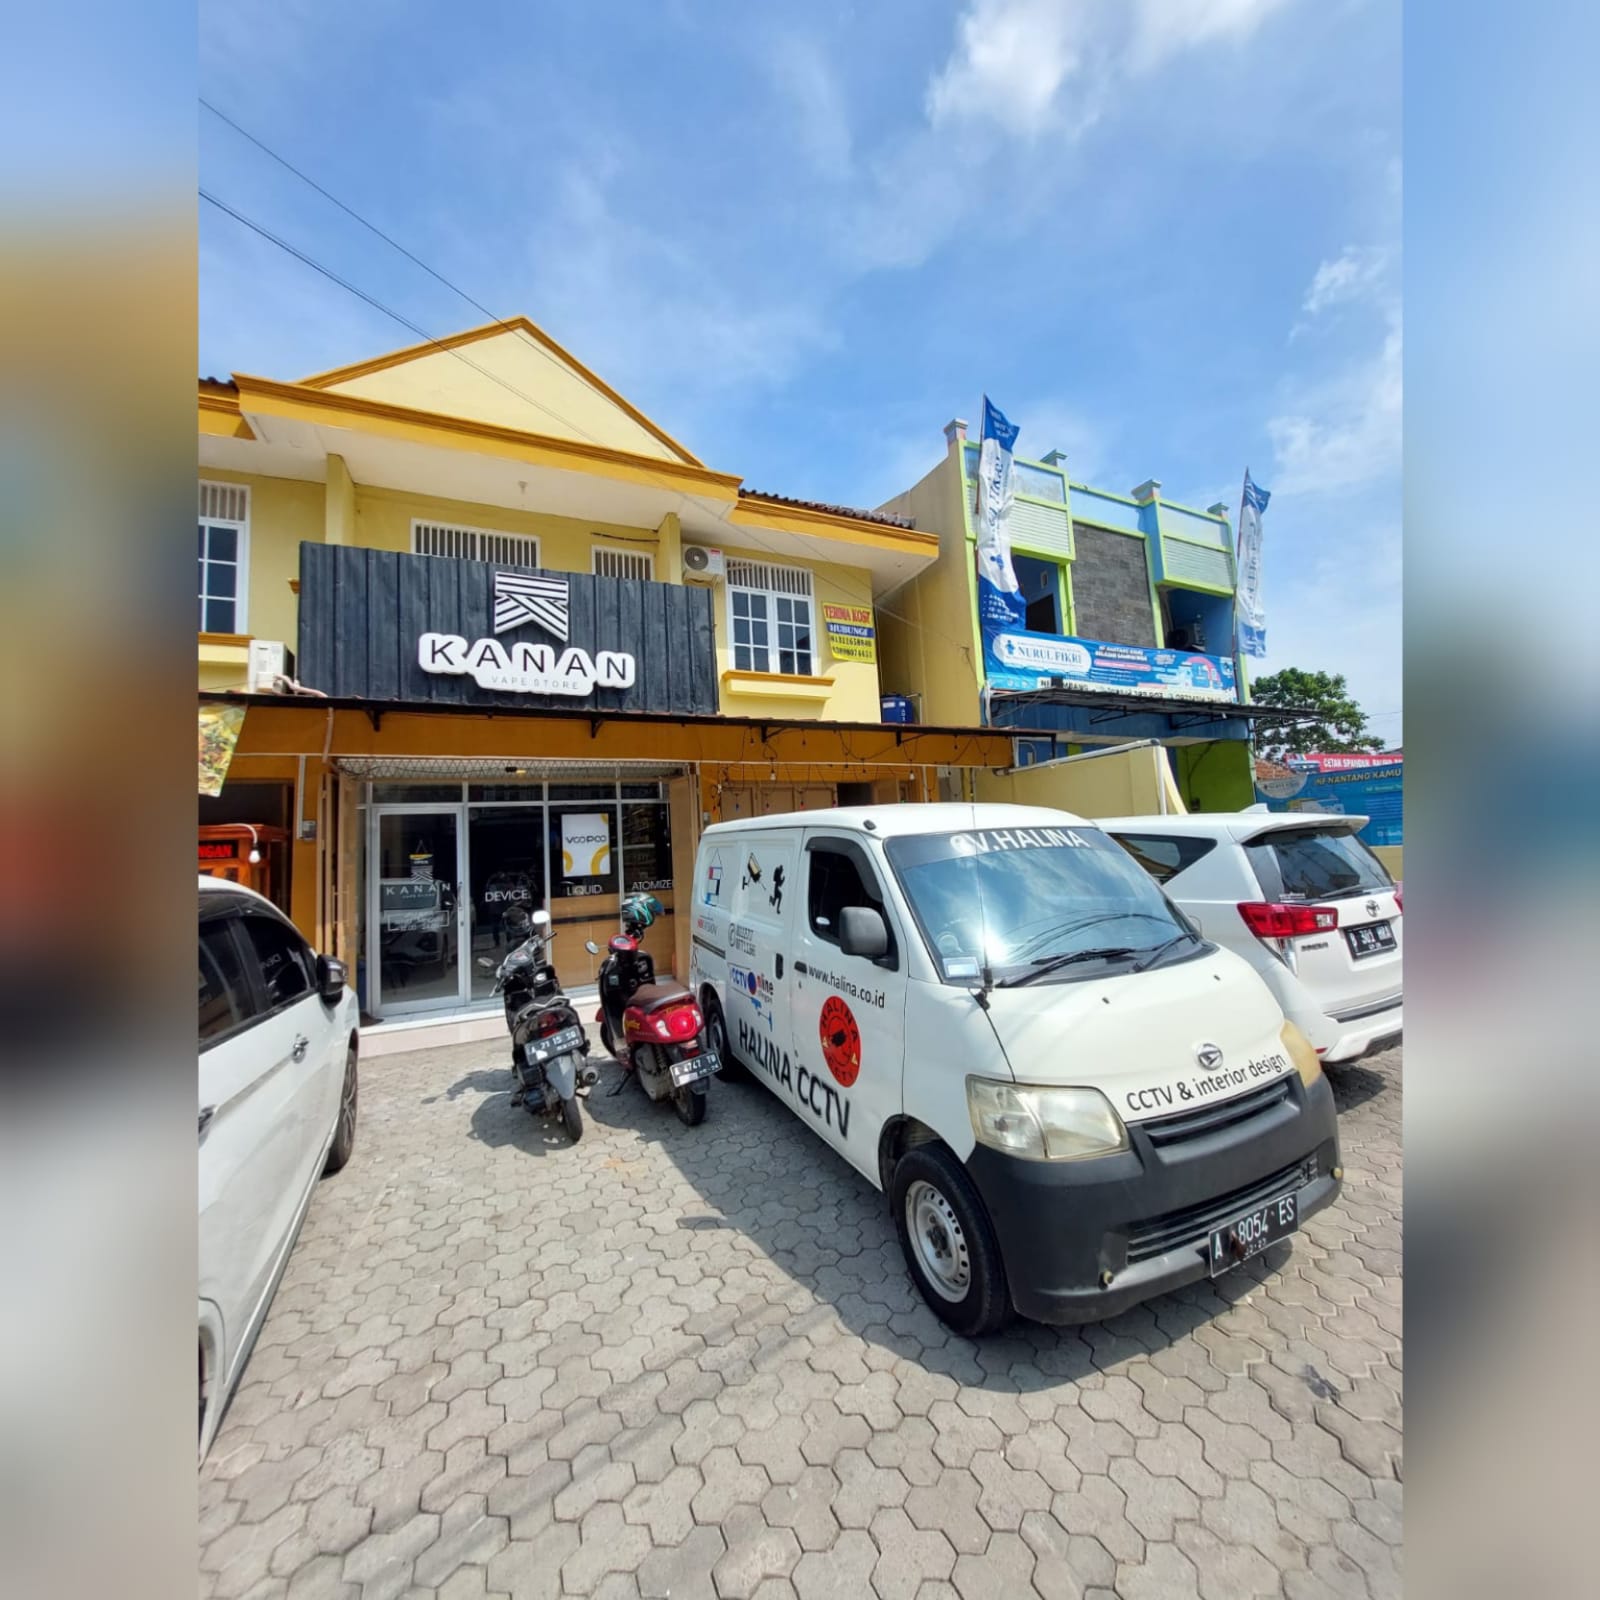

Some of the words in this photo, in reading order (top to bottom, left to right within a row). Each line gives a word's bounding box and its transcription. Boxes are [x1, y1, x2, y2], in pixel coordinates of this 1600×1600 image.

[431, 639, 626, 680] KANAN
[1018, 646, 1052, 660] NURUL
[1055, 650, 1082, 664] FIKRI
[491, 676, 527, 686] VAPE
[533, 679, 579, 690] STORE
[565, 834, 607, 844] VOOPOO
[385, 883, 451, 896] KANAN
[808, 965, 886, 1009] www.halina.co.id
[739, 1018, 793, 1093] HALINA
[797, 1065, 850, 1140] CCTV
[1126, 1085, 1174, 1111] CCTV
[1176, 1081, 1194, 1100] &
[1192, 1069, 1249, 1096] interior
[1248, 1053, 1287, 1078] design
[1215, 1232, 1223, 1259] A
[1238, 1209, 1269, 1245] 8054
[1279, 1197, 1295, 1226] ES
